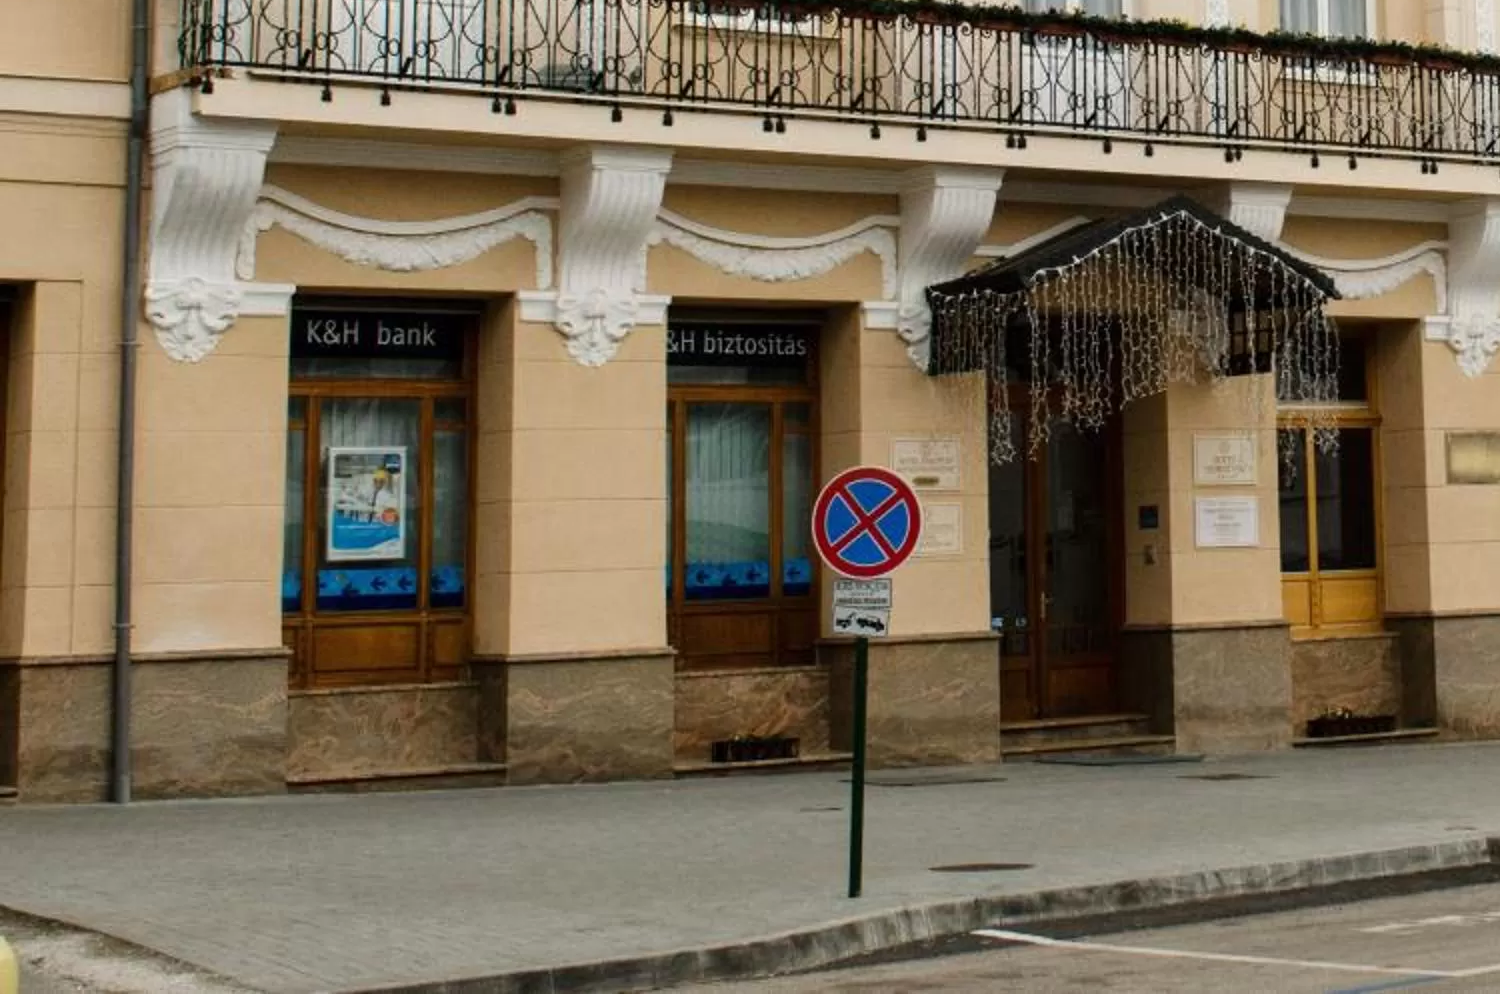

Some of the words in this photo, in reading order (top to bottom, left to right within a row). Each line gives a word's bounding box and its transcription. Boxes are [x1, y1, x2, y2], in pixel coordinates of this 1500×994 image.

[307, 319, 359, 344] K&H
[377, 319, 436, 346] bank
[667, 329, 695, 353] &H
